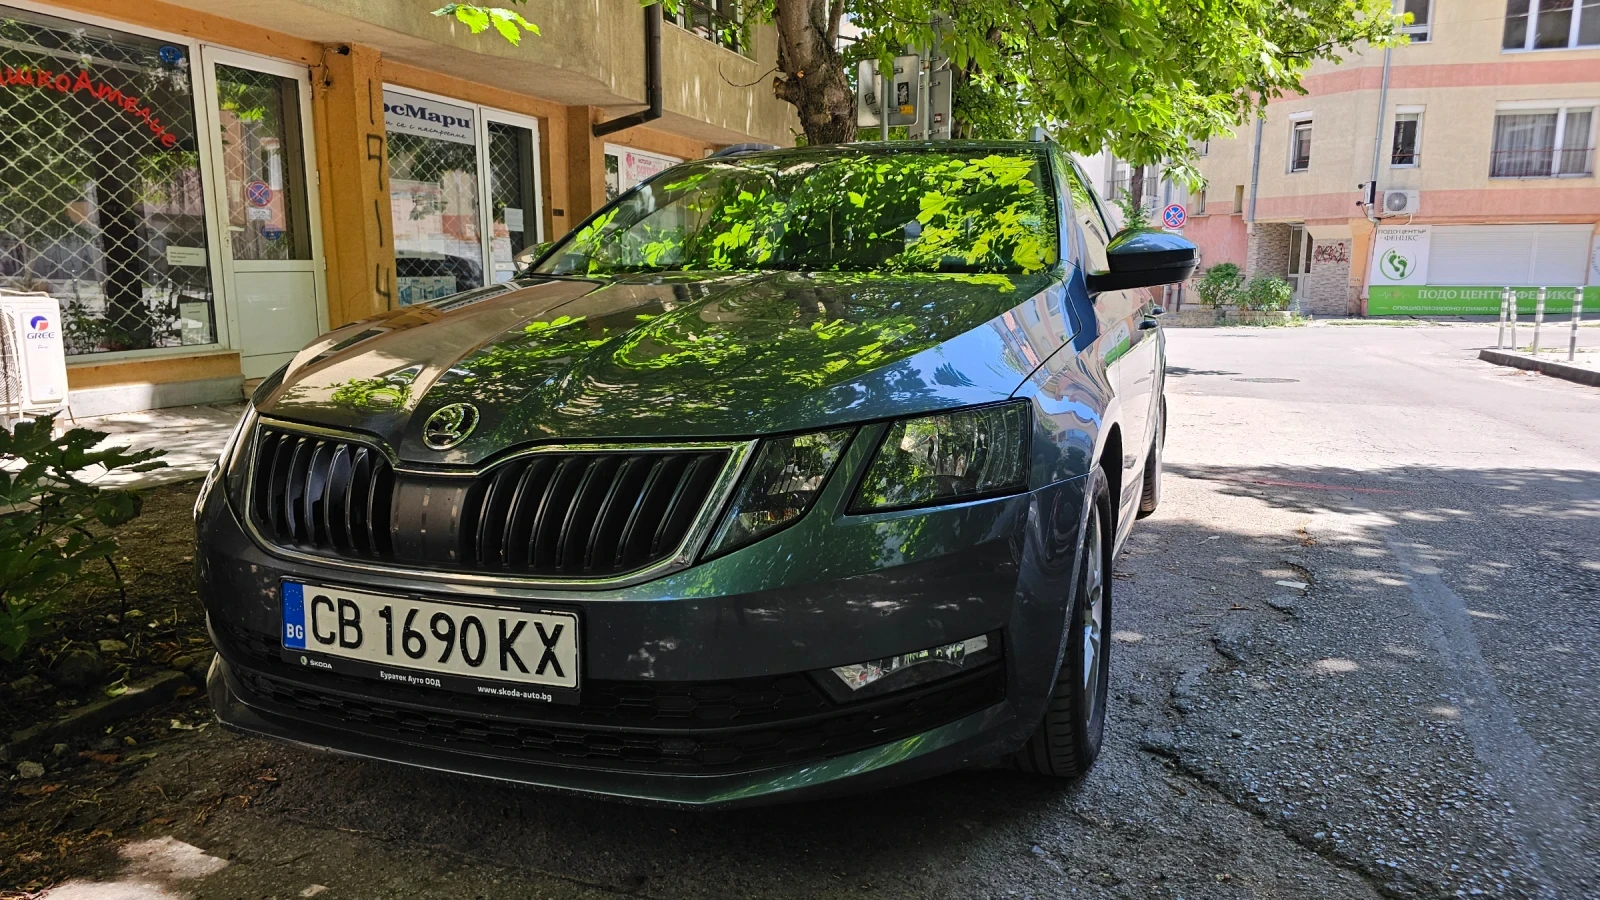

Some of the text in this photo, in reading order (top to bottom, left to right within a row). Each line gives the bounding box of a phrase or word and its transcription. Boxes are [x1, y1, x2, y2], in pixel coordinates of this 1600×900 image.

[1418, 289, 1457, 300] ПОДО
[1516, 290, 1575, 300] ФЕИКС
[27, 332, 55, 340] GREE
[286, 623, 304, 640] BG
[311, 594, 566, 678] CB 1690 KX
[380, 670, 441, 687] Еуратек Ауто ООД
[477, 686, 552, 702] www.skoda-auto.bg
